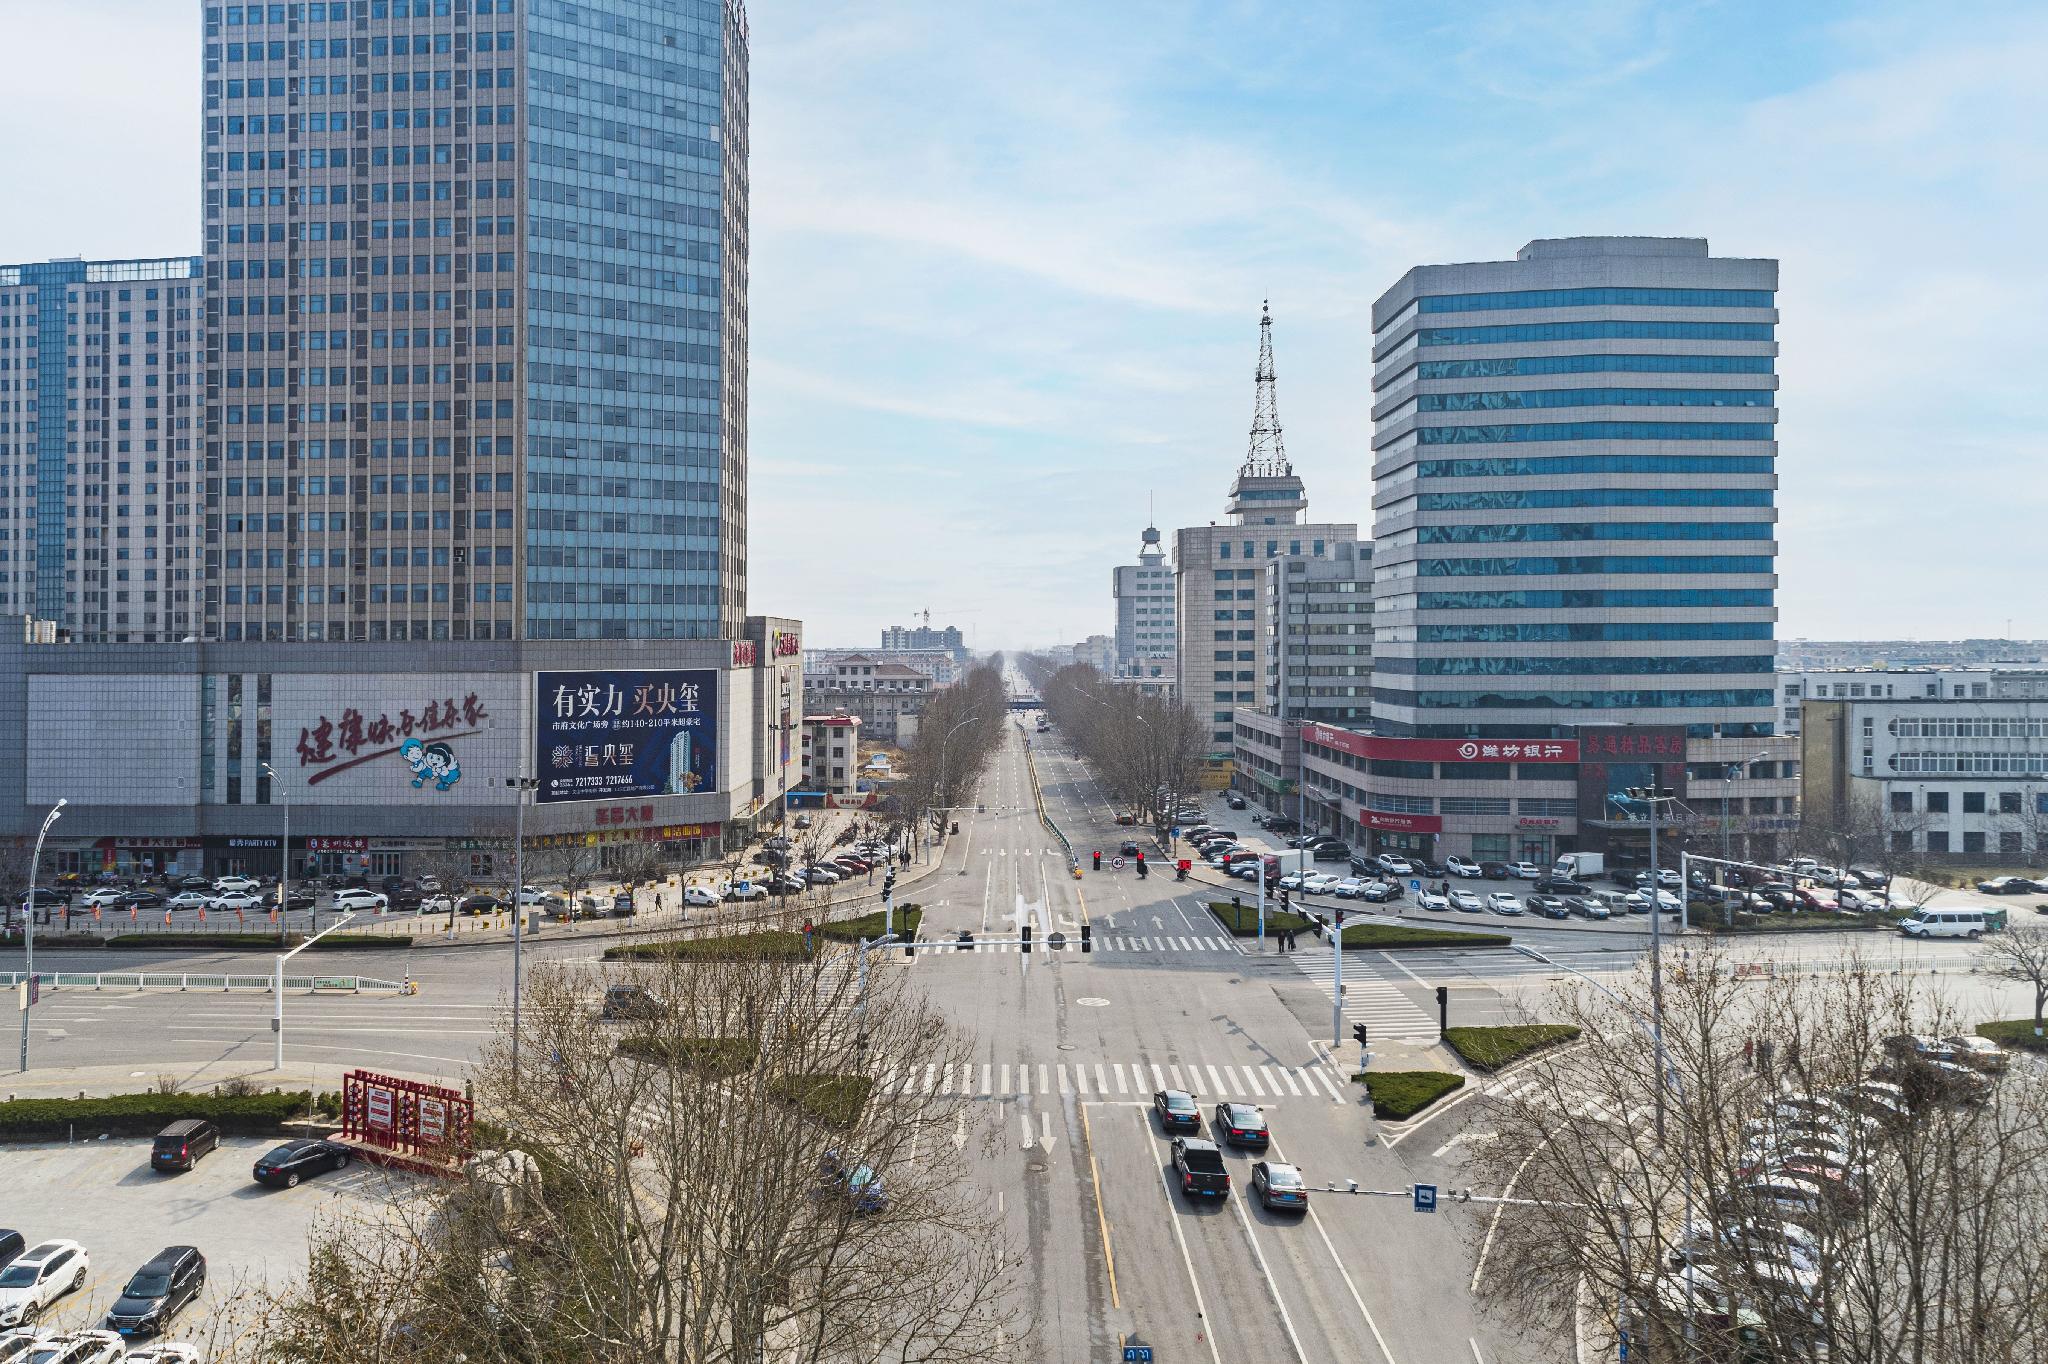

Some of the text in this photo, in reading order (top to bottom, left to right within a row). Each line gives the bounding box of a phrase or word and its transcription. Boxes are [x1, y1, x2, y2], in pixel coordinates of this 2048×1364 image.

[552, 682, 700, 717] 有实力 买央玺
[552, 720, 609, 731] 市府文化广场旁
[1482, 744, 1563, 758] 潍坊银行
[575, 777, 603, 787] 7217333
[605, 775, 633, 786] 7217666
[244, 839, 263, 847] PARTY
[264, 839, 277, 847] KTV
